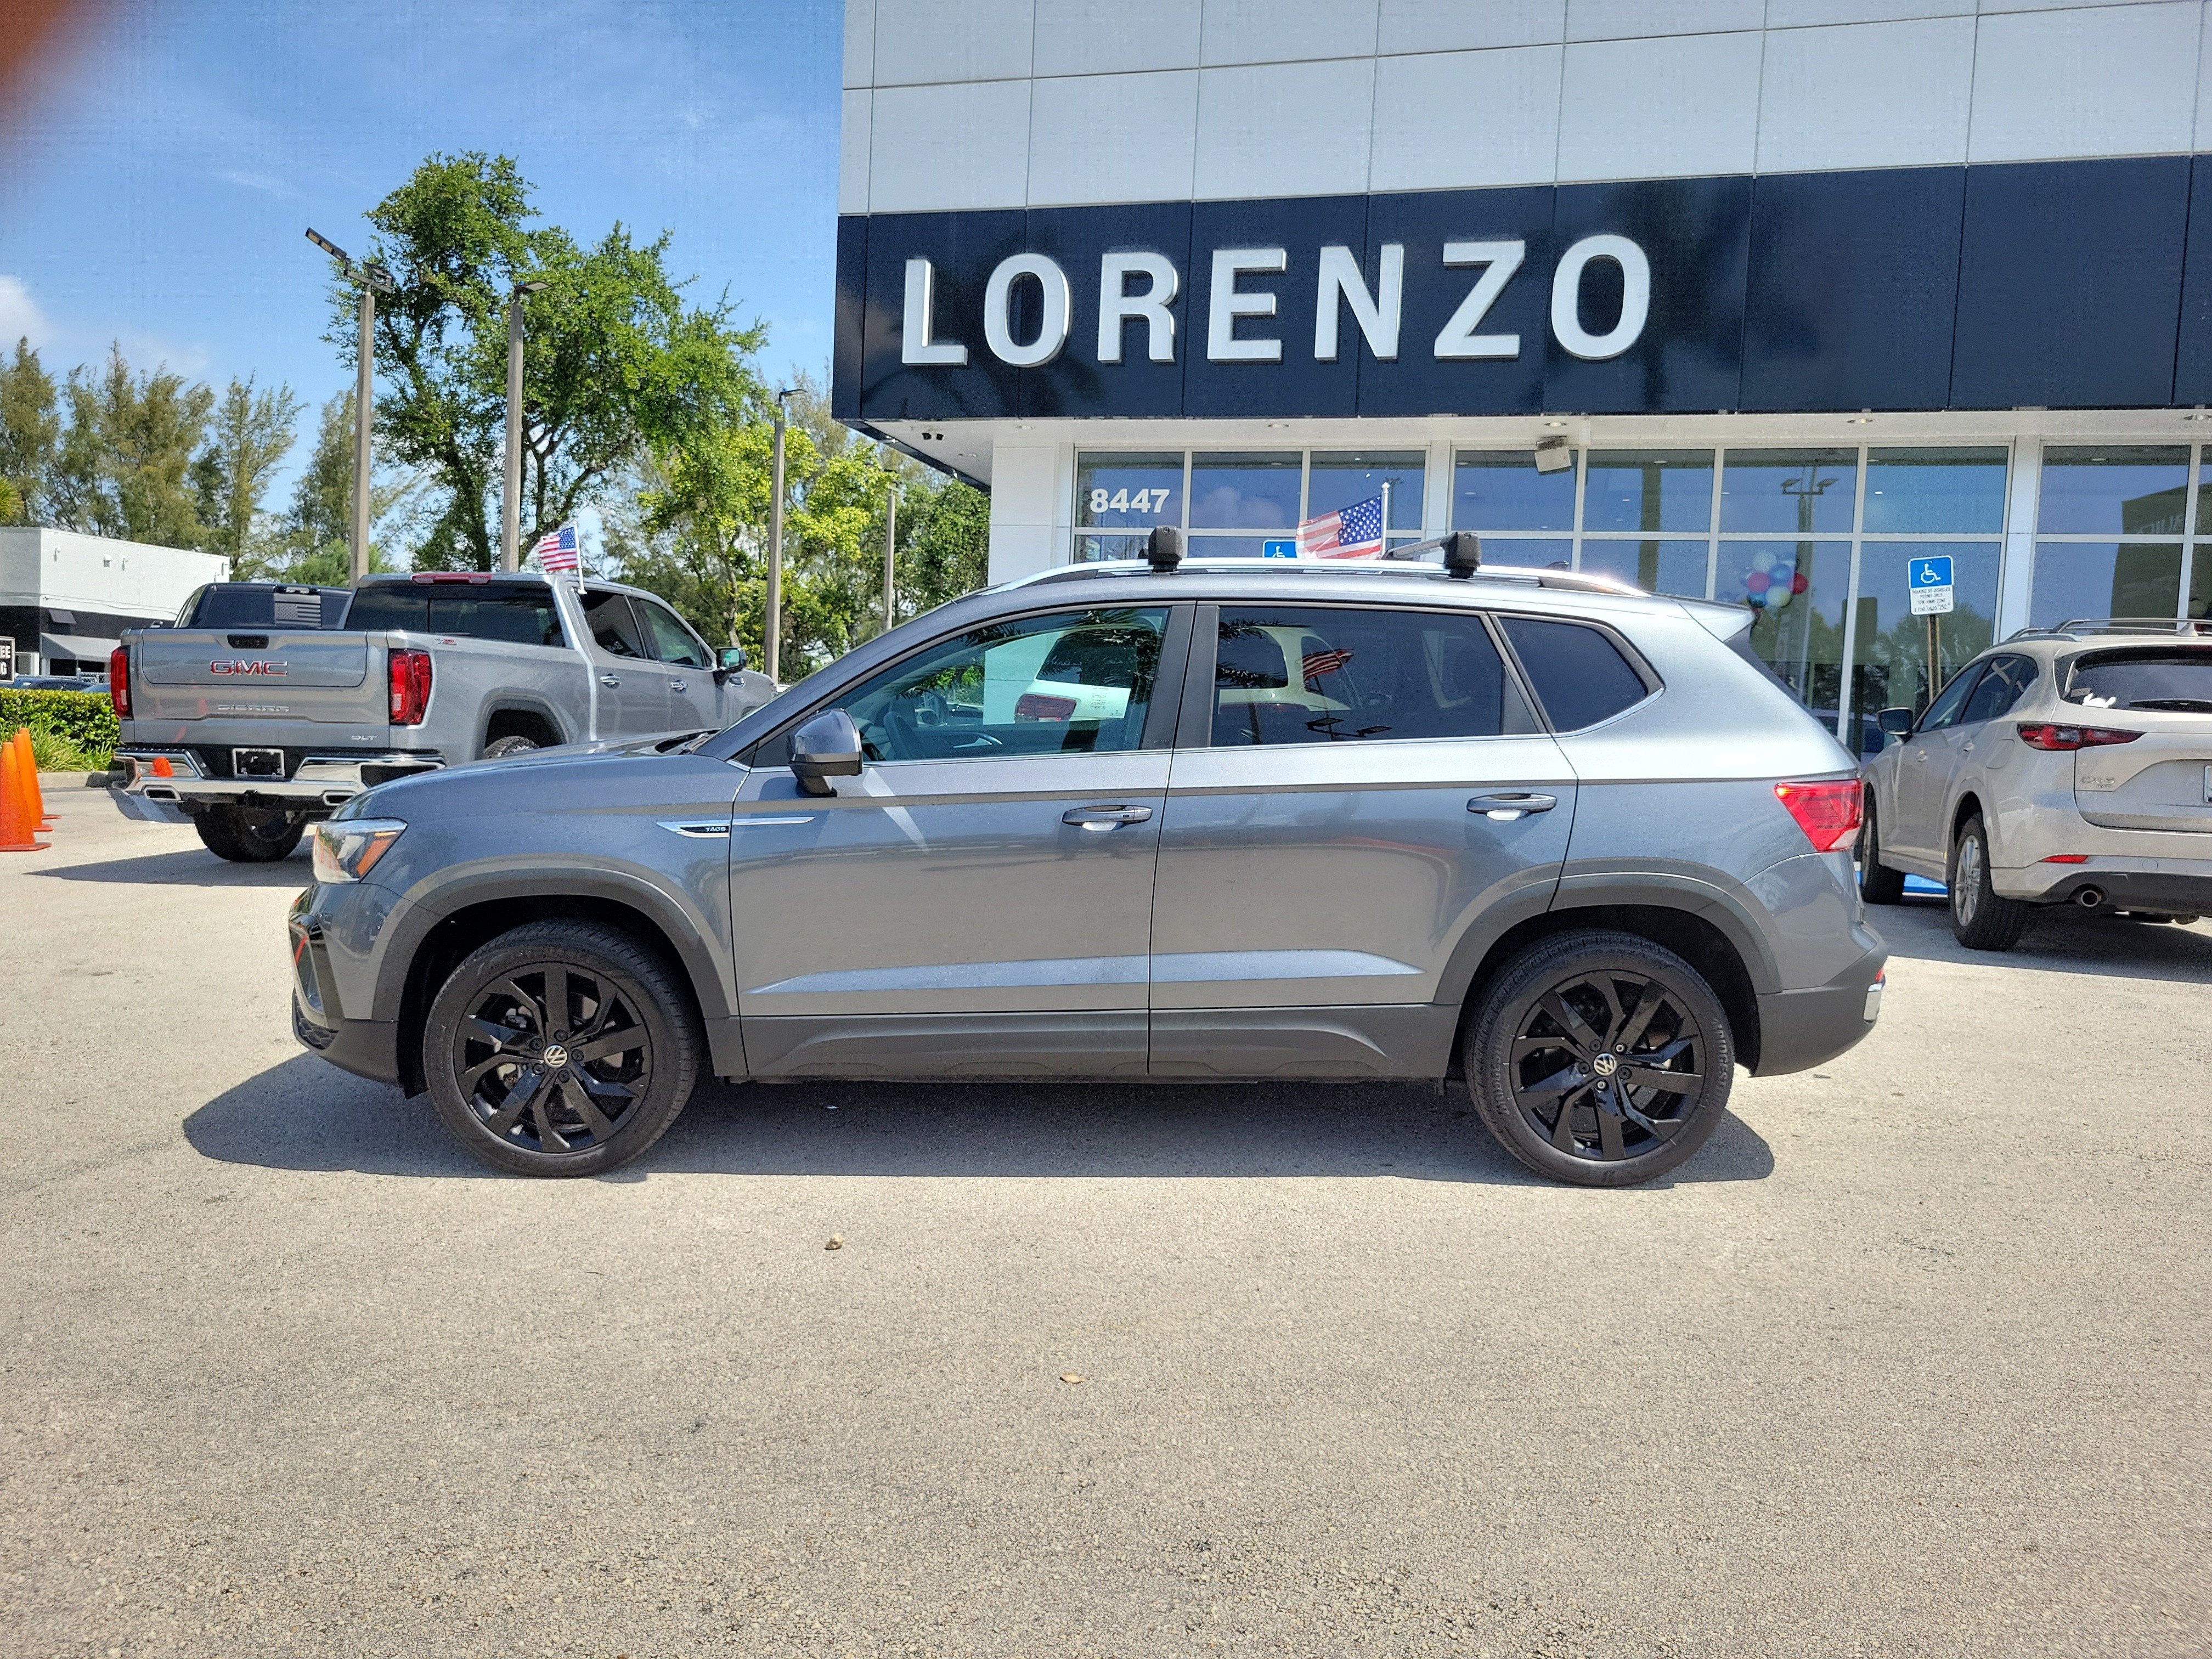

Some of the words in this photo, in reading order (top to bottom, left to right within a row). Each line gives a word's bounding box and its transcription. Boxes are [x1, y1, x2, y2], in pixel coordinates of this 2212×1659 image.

[901, 234, 1650, 368] LORENZO
[1090, 488, 1170, 513] 8447
[211, 659, 289, 676] GMC
[218, 704, 290, 713] SIERRA
